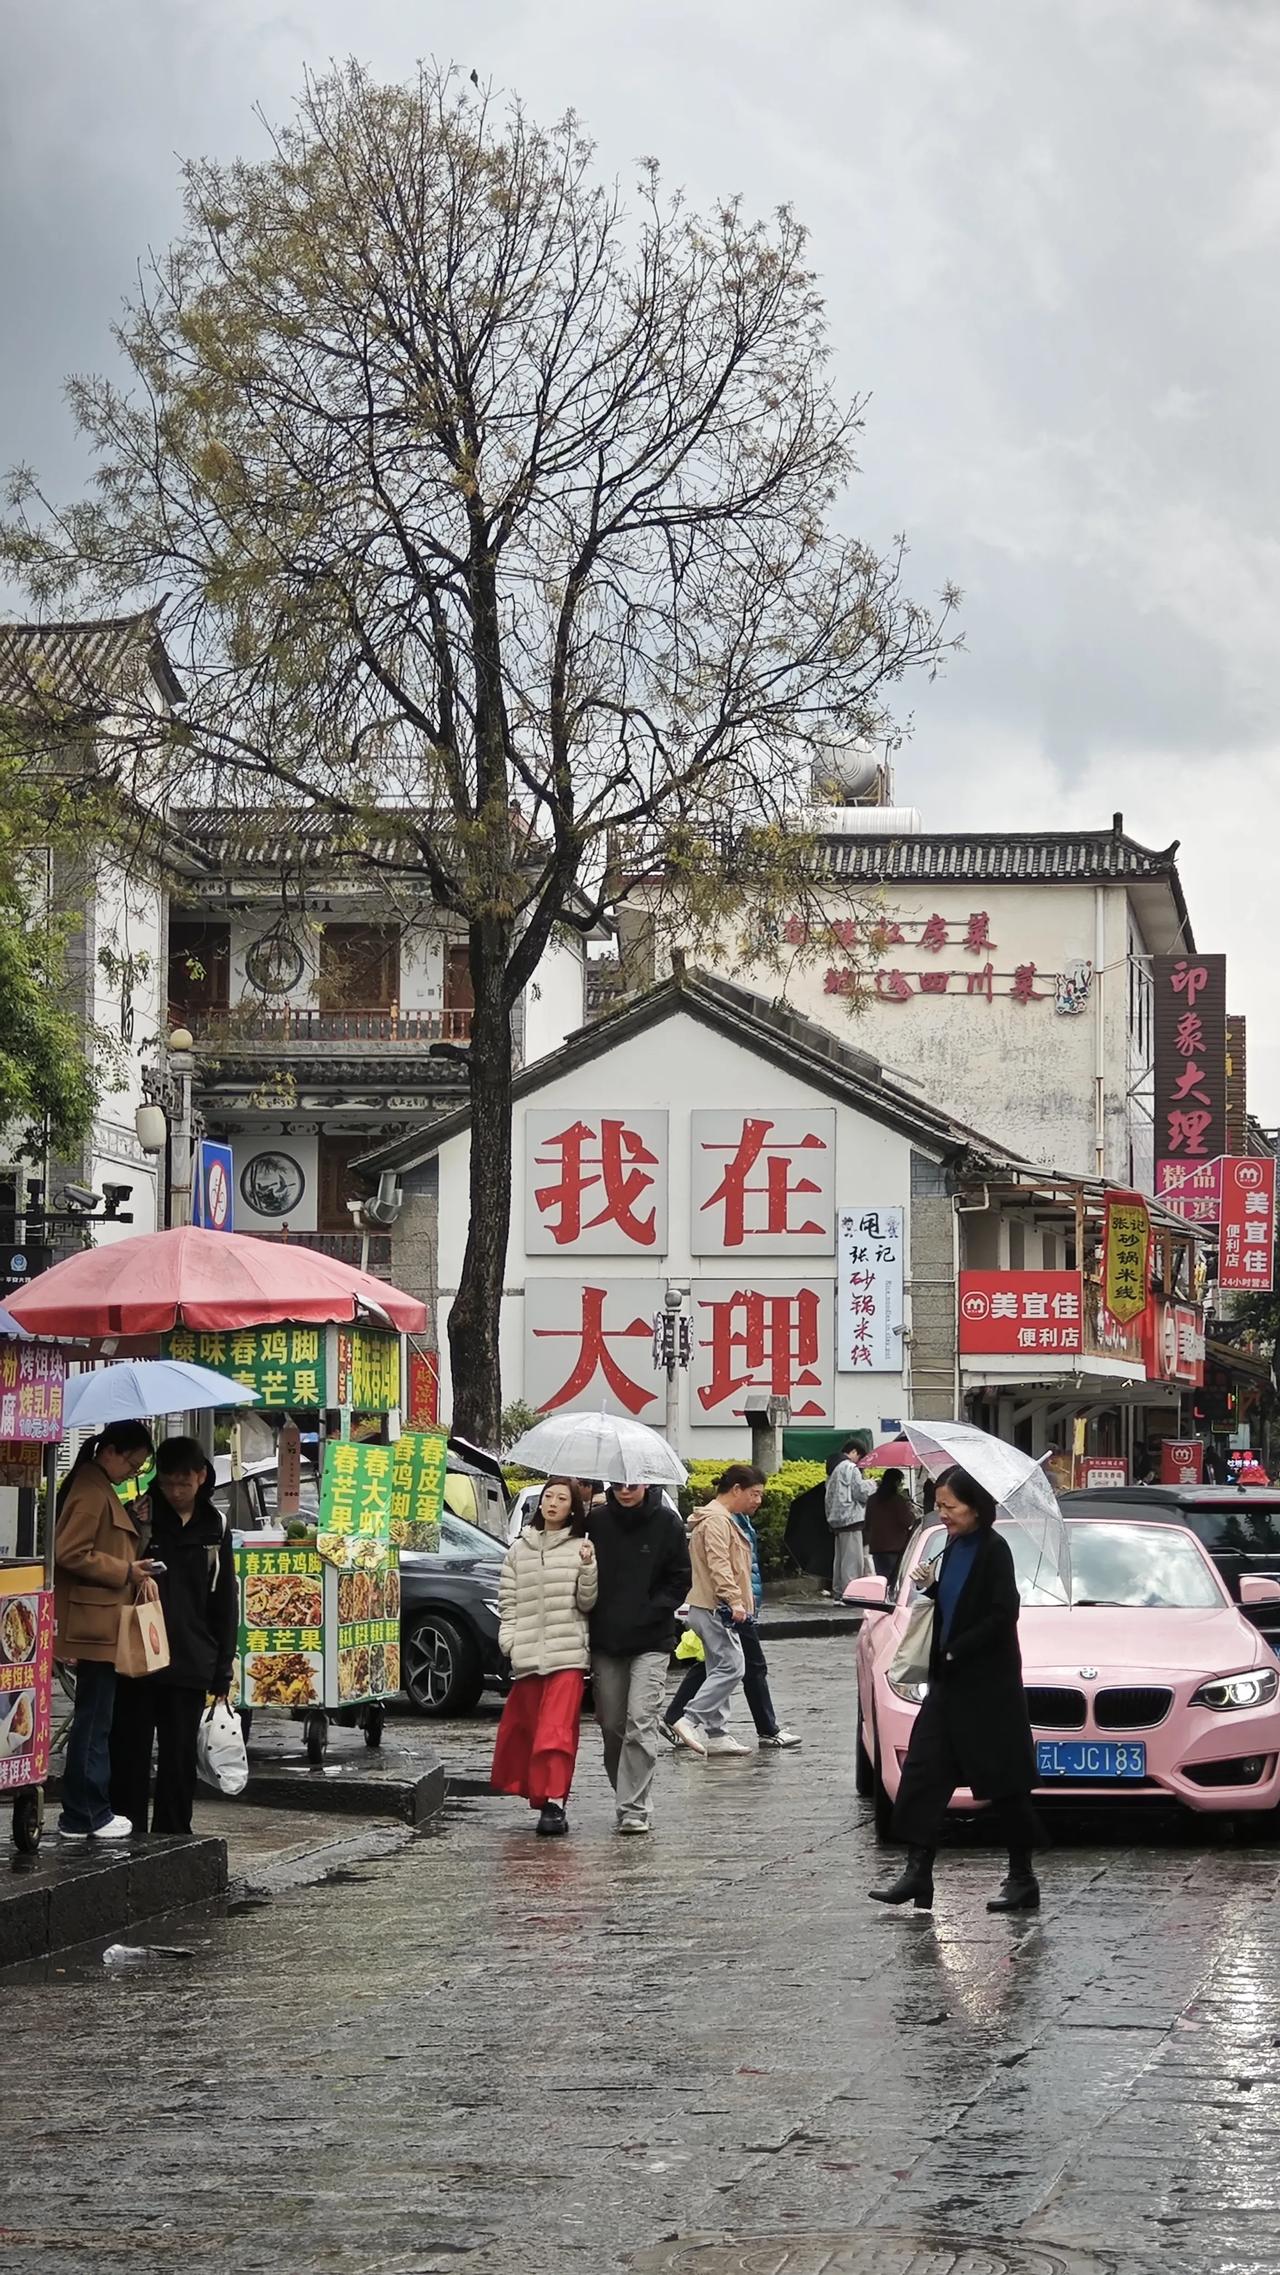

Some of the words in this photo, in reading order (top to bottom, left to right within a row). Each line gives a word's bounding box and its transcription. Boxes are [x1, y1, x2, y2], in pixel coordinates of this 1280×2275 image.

[1167, 961, 1212, 1154] 印象大理
[534, 1118, 827, 1246] 我在
[1162, 1165, 1216, 1188] 精品
[1112, 1217, 1146, 1233] 张记
[1224, 1223, 1240, 1267] 便利店
[1243, 1191, 1270, 1273] 美宜佳
[849, 1244, 896, 1264] 张记
[1114, 1233, 1140, 1300] 砂锅米线
[990, 1292, 1080, 1319] 美宜佳
[1222, 1277, 1270, 1290] 24小时营业
[850, 1269, 876, 1367] 砂锅米线
[1017, 1327, 1080, 1347] 便利店
[20, 1347, 64, 1383] 烤饵块
[533, 1286, 824, 1417] 大理
[18, 1383, 63, 1420] 烤乳扇
[328, 1444, 359, 1536] 舂芒果
[360, 1448, 390, 1538] 舂大虾
[246, 1629, 322, 1652] 舂芒果
[35, 1598, 51, 1776] 大理特色小吃
